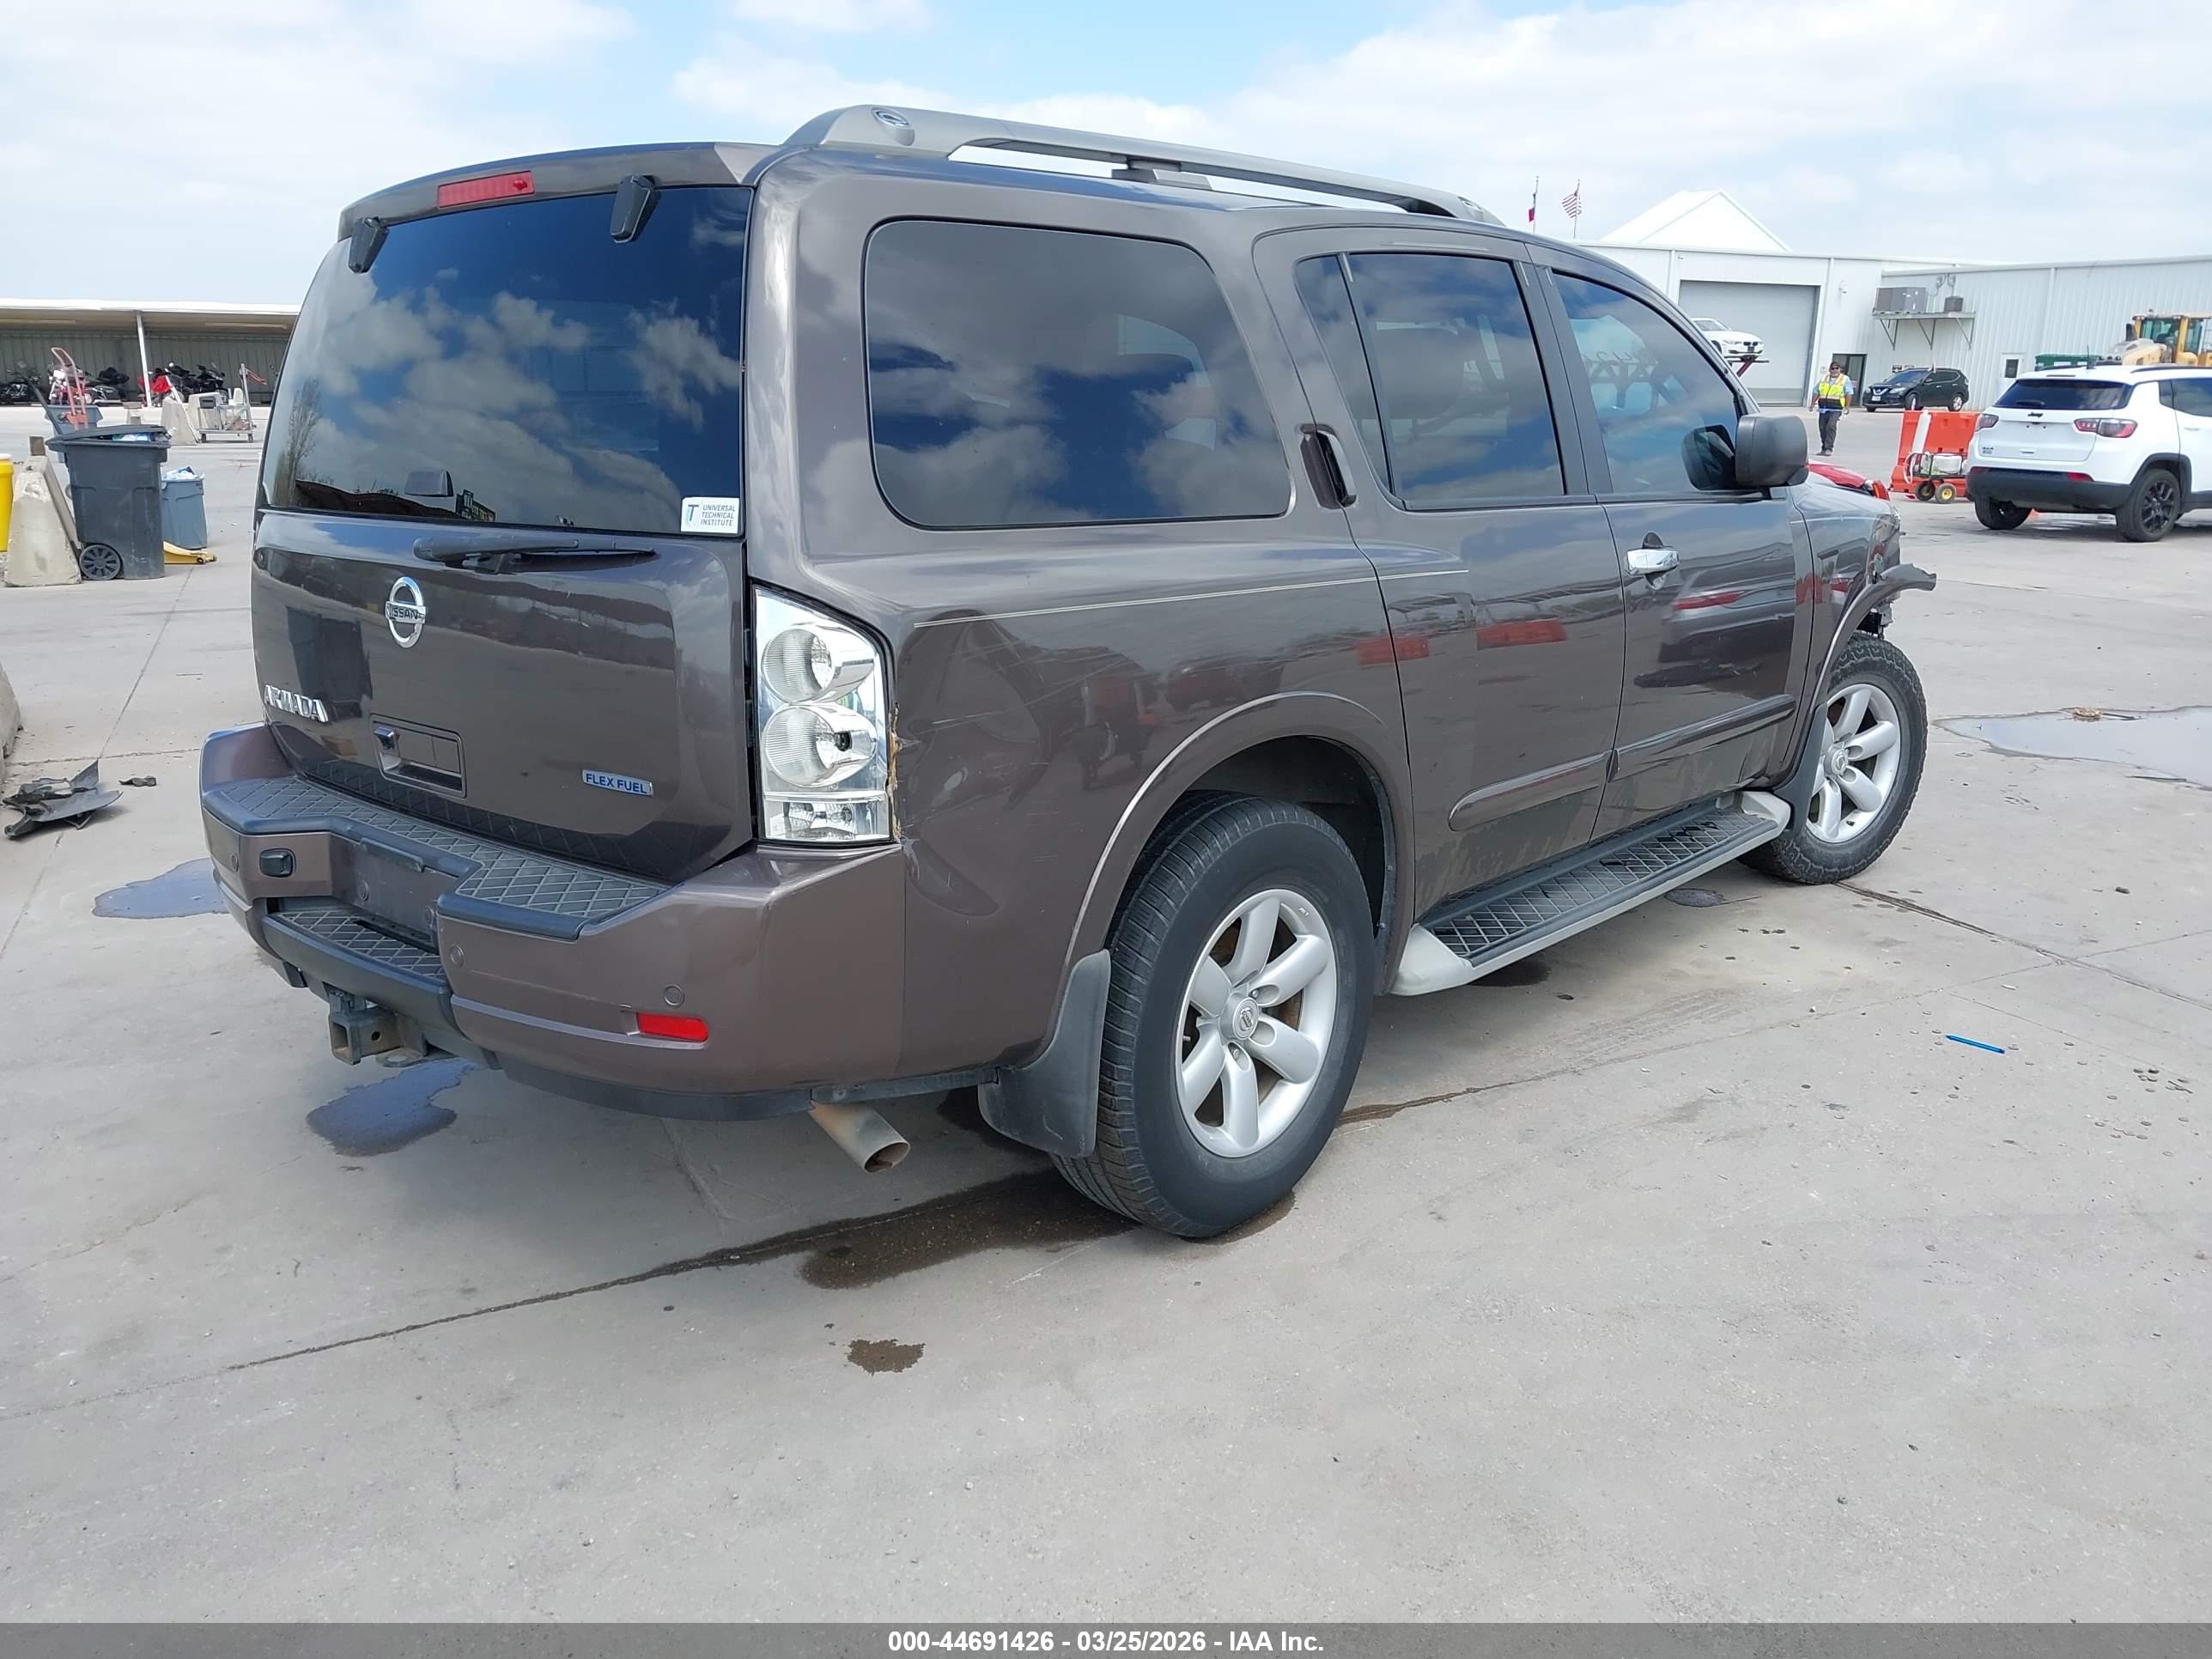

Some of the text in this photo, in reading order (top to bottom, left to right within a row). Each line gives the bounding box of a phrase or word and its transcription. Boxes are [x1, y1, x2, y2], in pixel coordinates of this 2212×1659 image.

[386, 603, 419, 620] NISSAN
[264, 684, 329, 722] ARMADA
[586, 773, 647, 794] FLEX FUEL
